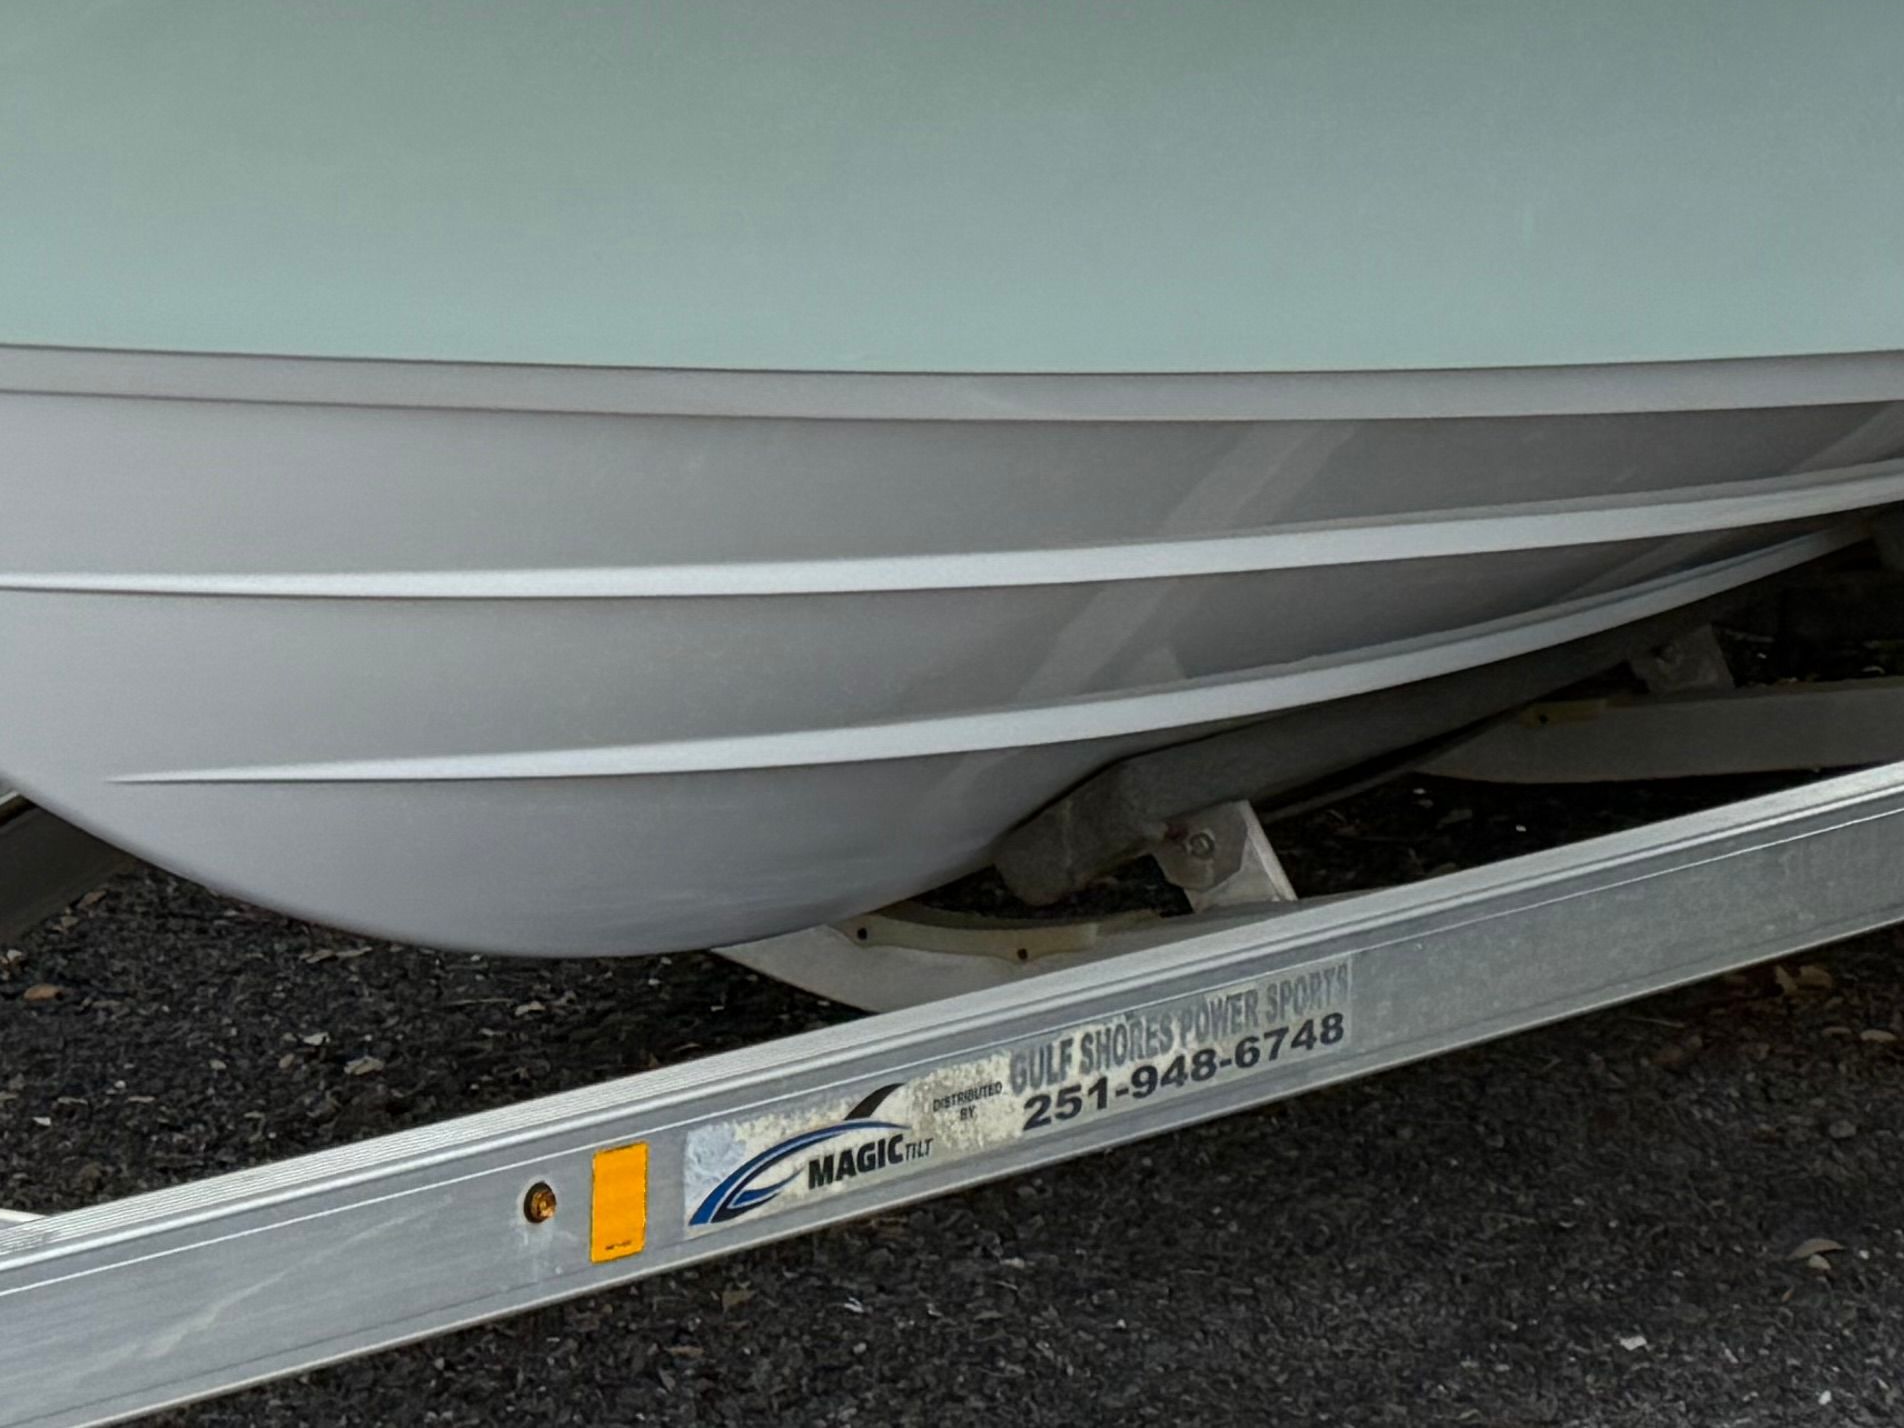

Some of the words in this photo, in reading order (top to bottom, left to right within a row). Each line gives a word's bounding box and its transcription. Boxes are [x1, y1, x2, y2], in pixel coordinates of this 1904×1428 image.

[1010, 1032, 1075, 1094] GULF
[1079, 1011, 1175, 1075] SHORES
[1179, 987, 1260, 1046] POWER
[932, 1081, 1003, 1113] DISTRIBUTED
[1022, 1012, 1344, 1131] 251-948-6748
[960, 1105, 975, 1120] BY
[808, 1134, 904, 1190] MAGIC
[905, 1138, 934, 1162] TILT
